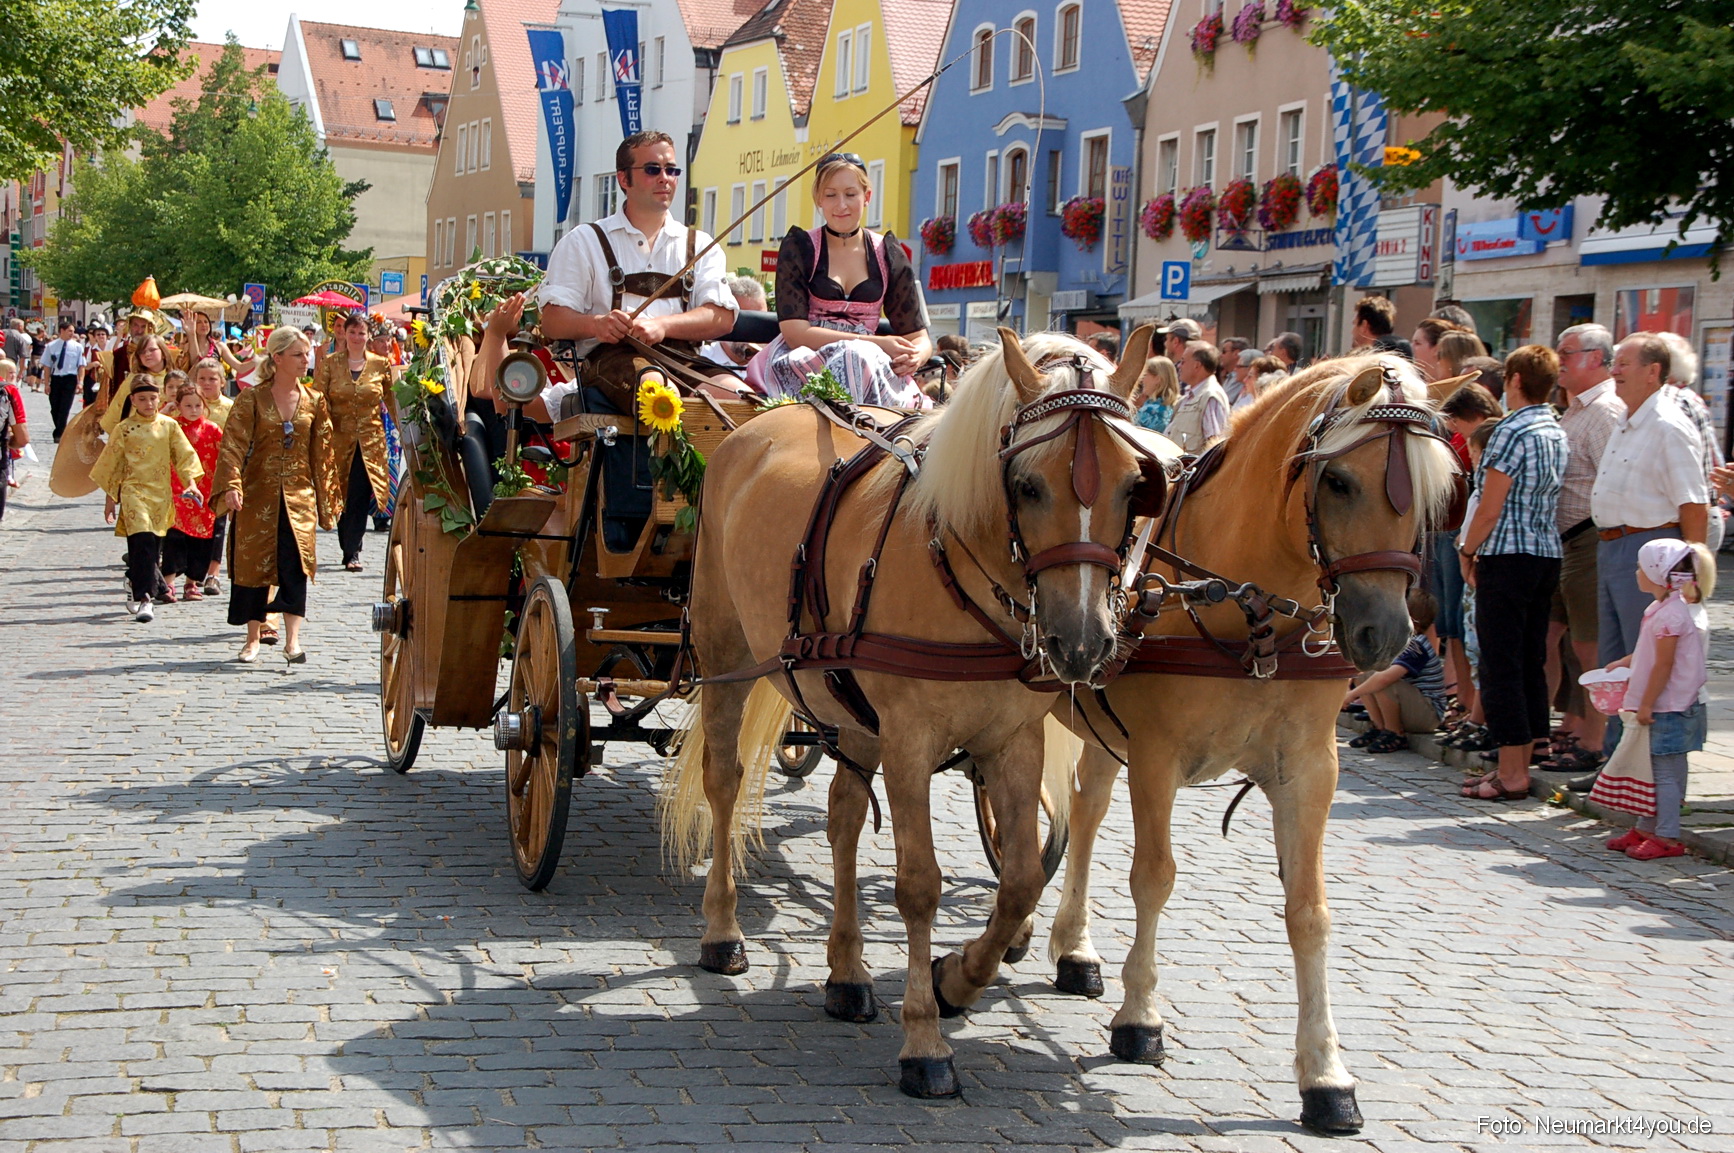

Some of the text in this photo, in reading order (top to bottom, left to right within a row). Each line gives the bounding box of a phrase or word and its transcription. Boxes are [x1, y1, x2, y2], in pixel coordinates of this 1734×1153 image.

[626, 89, 641, 137] PERT
[739, 147, 801, 174] HOTEL Lehmeier
[1112, 186, 1128, 265] WITTL
[1420, 209, 1433, 280] KINO
[763, 257, 778, 266] WIS
[928, 260, 993, 290] APOTHEKE
[1167, 265, 1185, 296] P
[251, 303, 263, 312] AXI
